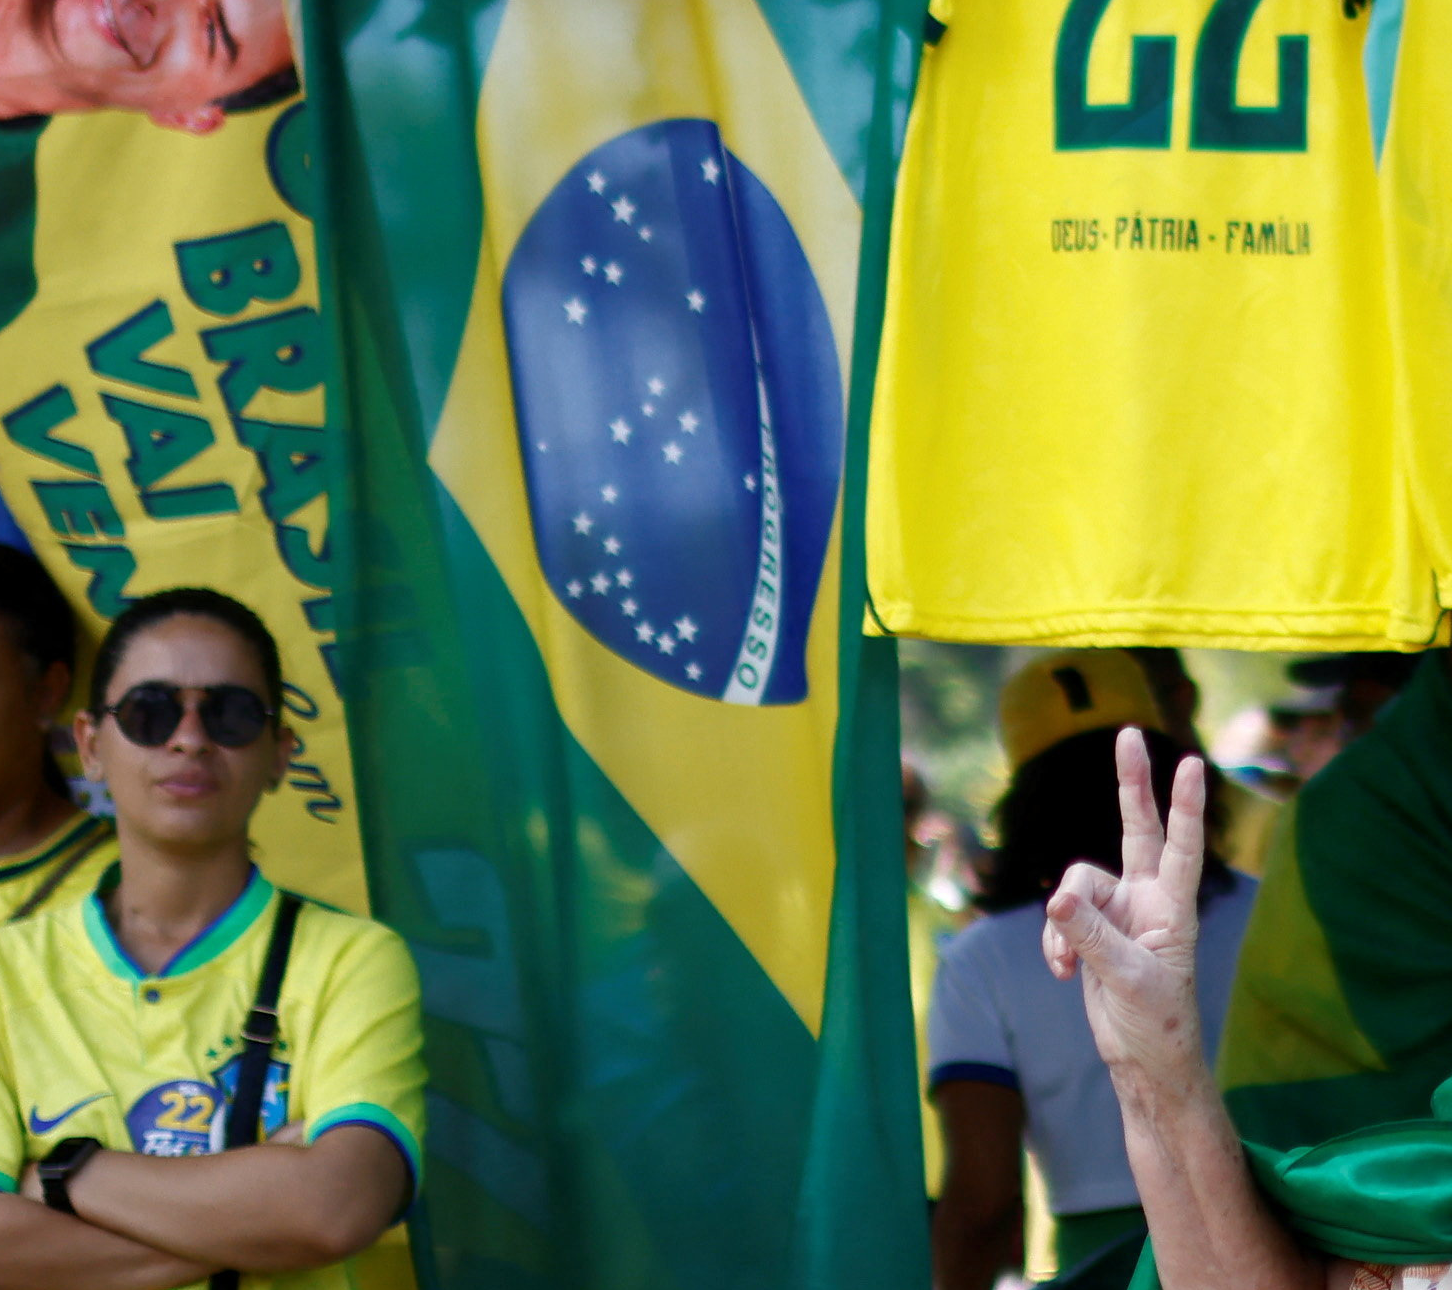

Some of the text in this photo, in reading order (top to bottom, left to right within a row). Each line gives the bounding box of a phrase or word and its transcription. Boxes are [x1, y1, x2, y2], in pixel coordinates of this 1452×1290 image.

[1051, 218, 1098, 253] DEUS
[1114, 210, 1199, 251] PÁTRIA
[1225, 215, 1311, 255] FAMÍLIA
[85, 299, 241, 522] VAI
[155, 1090, 214, 1134] 22
